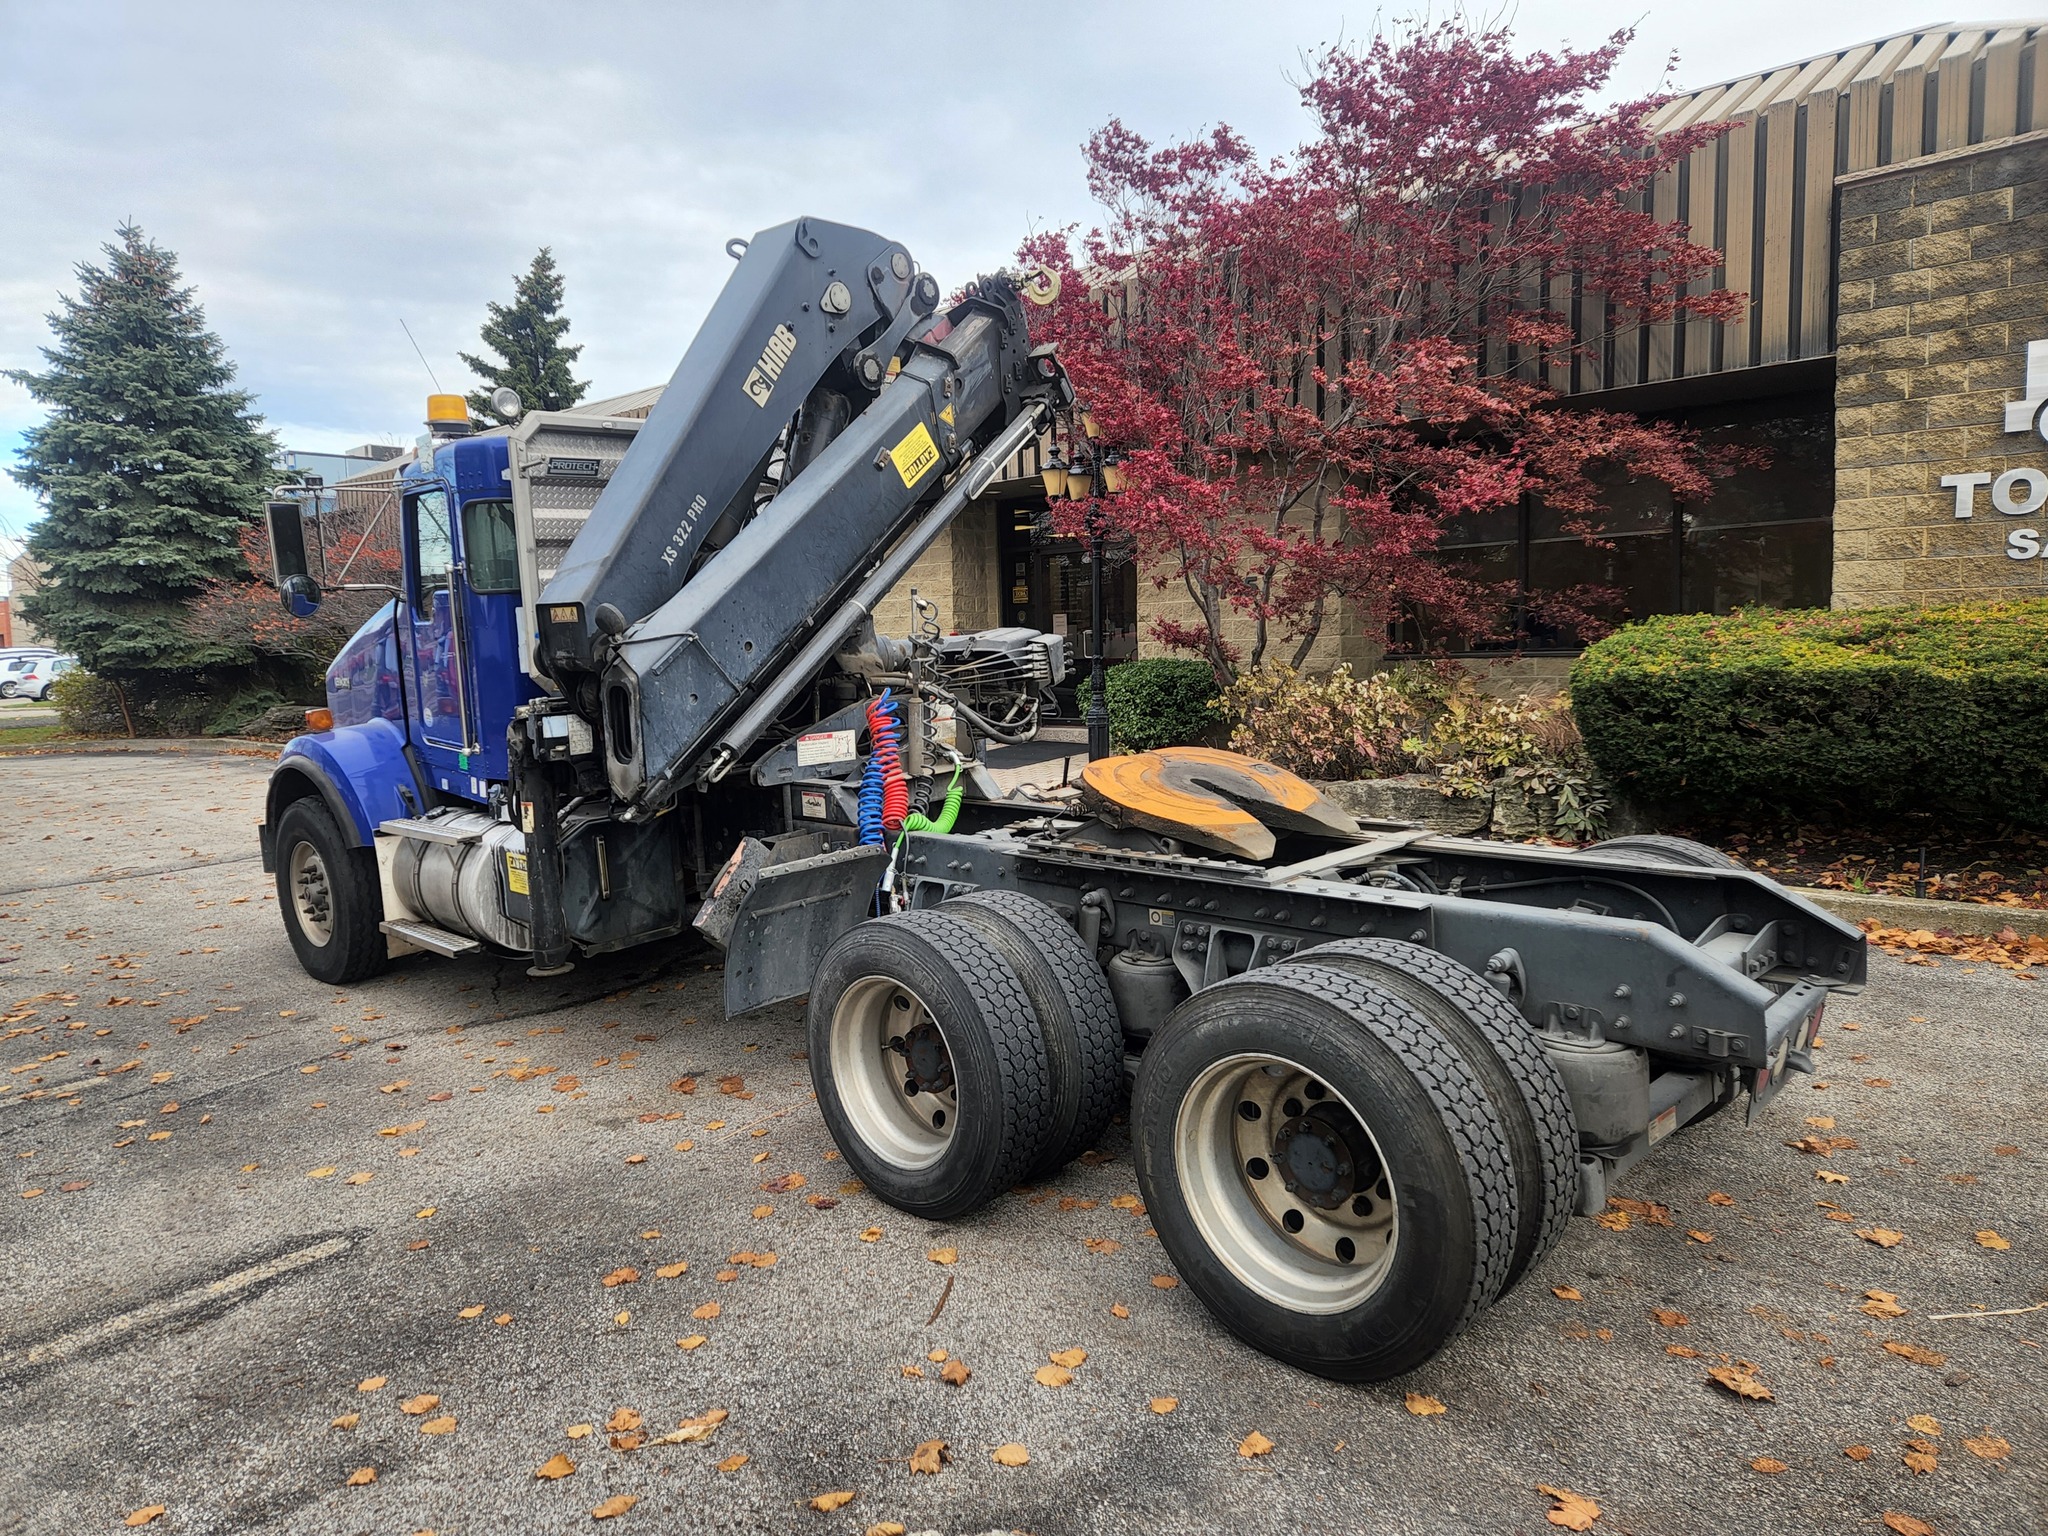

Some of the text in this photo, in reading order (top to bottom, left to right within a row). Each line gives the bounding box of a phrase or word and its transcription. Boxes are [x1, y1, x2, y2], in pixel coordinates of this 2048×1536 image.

[757, 323, 797, 382] HIAB
[551, 461, 598, 471] PROTECH
[903, 446, 935, 481] CAUTION
[661, 494, 707, 567] XS 322 PRO
[2006, 528, 2048, 560] S
